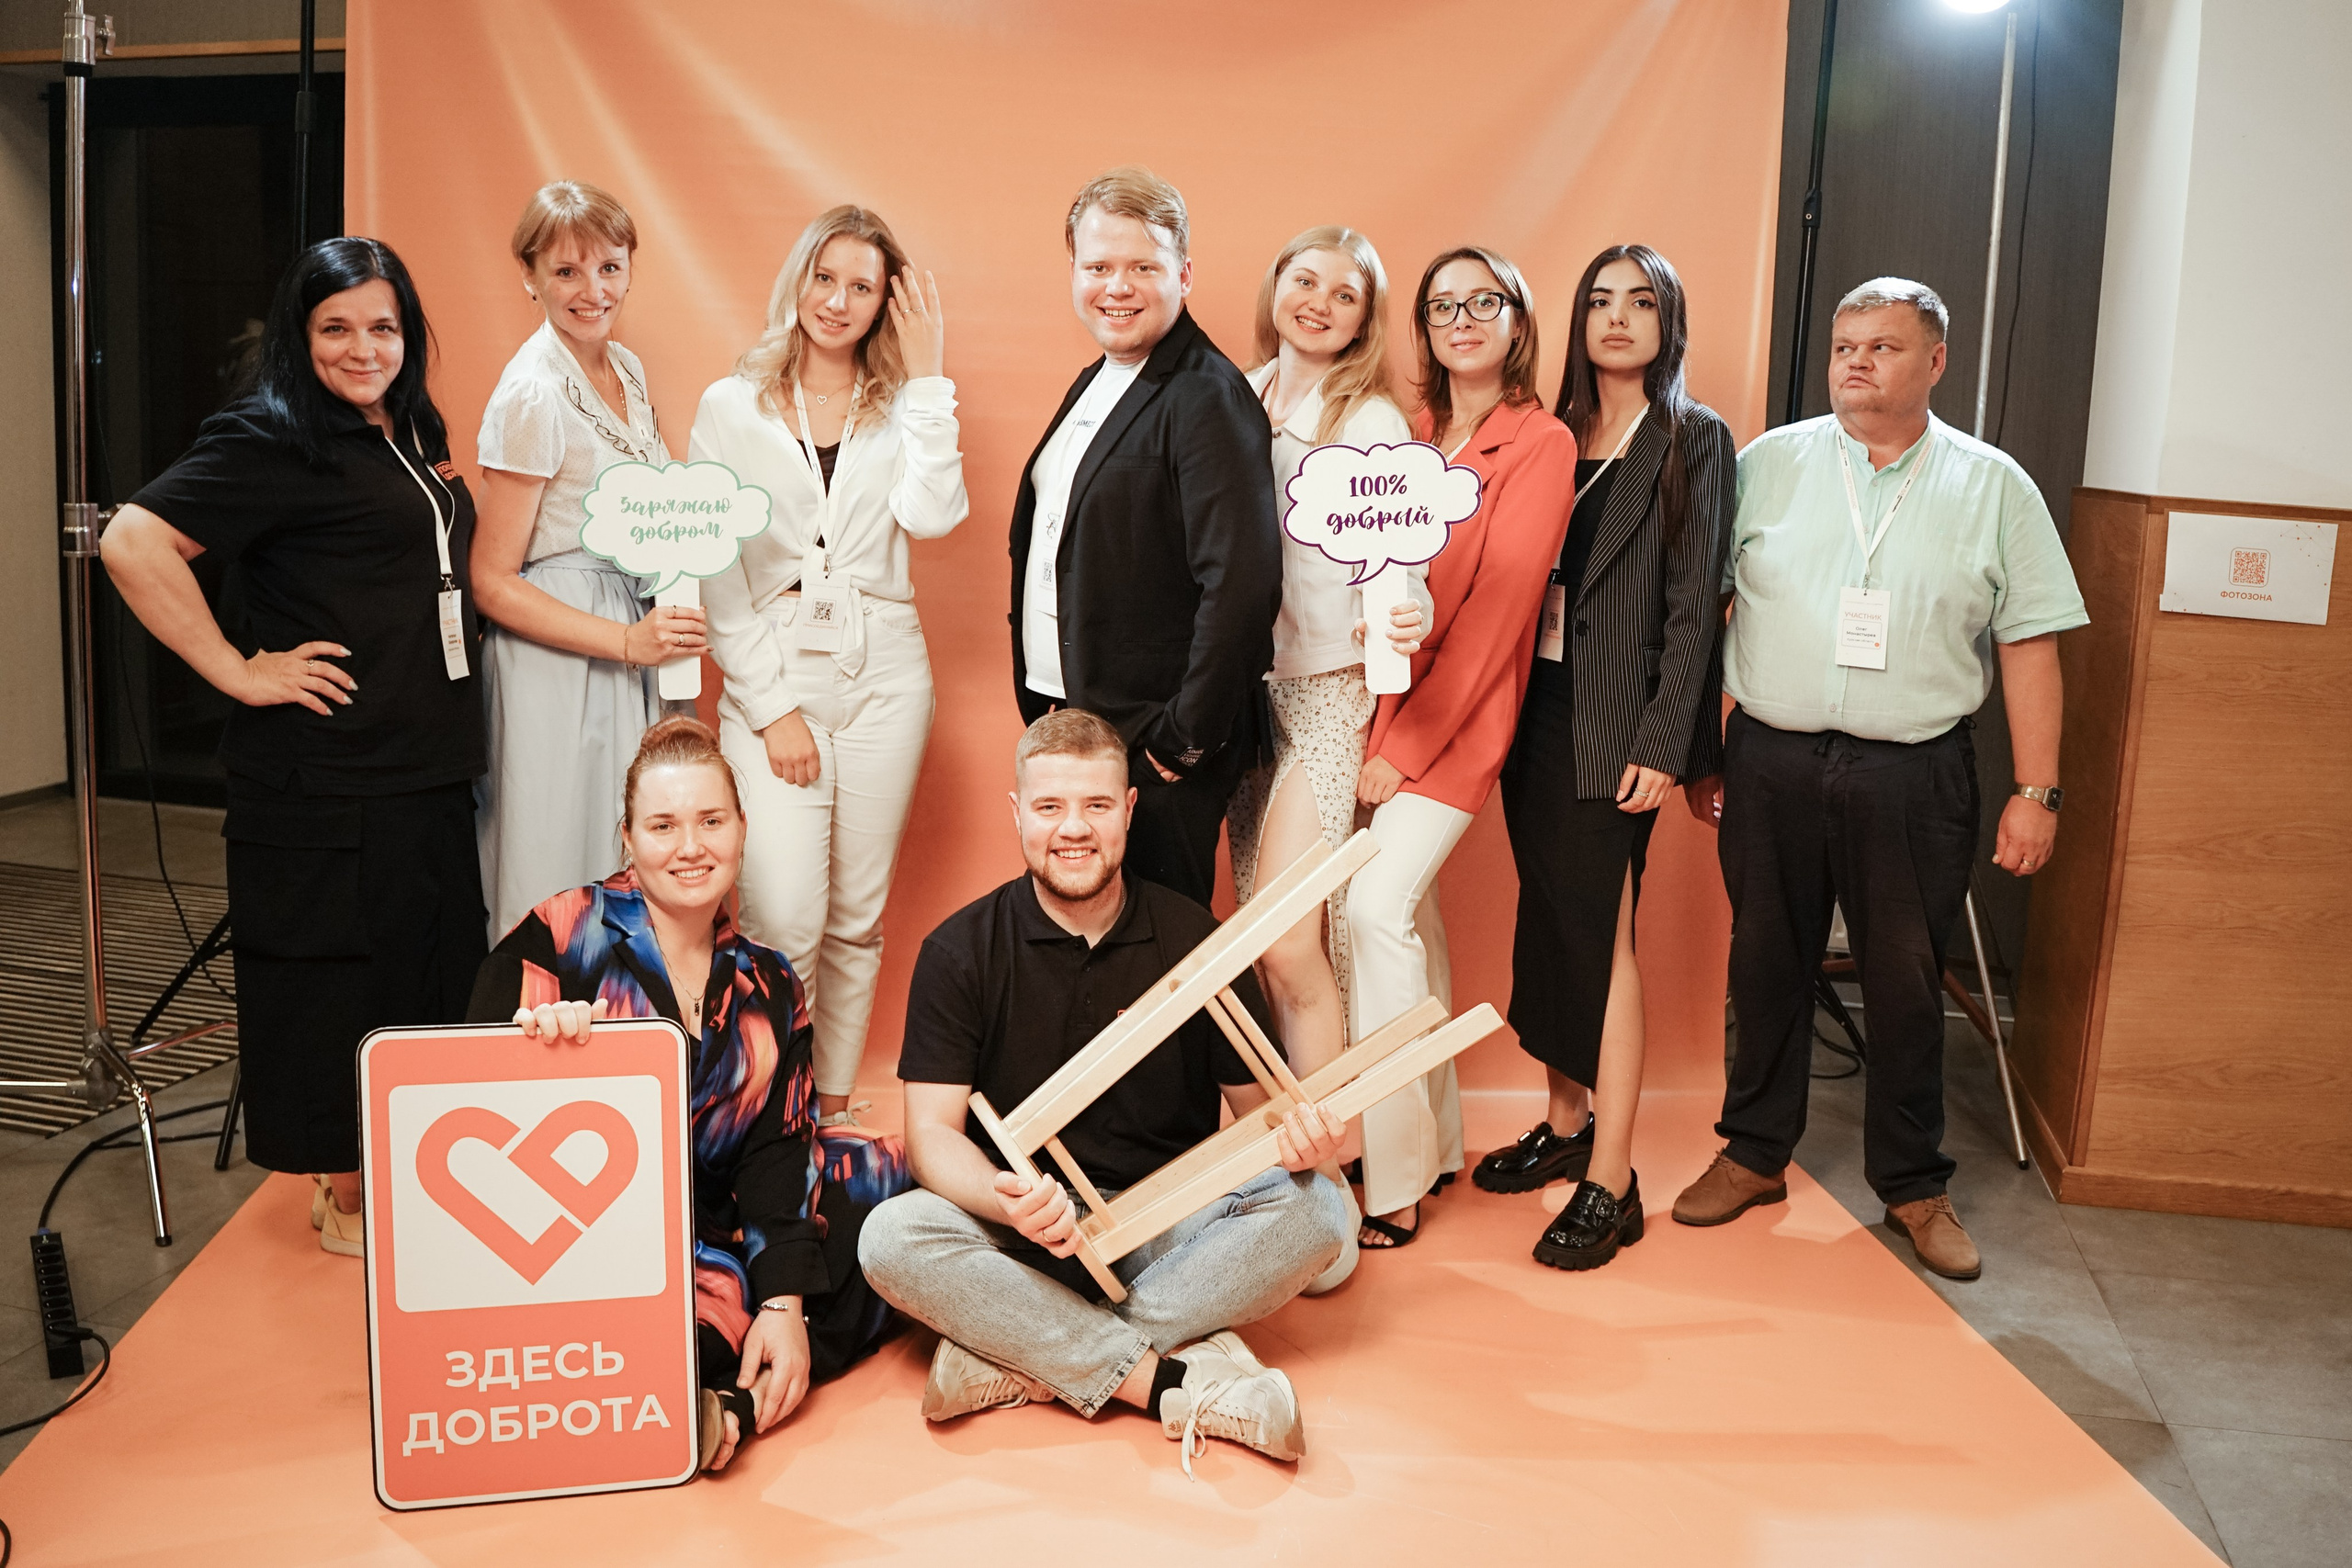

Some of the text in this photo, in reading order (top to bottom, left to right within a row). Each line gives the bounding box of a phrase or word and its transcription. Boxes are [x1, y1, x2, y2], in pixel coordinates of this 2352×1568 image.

[1349, 474, 1408, 497] 100%
[629, 520, 724, 545] добром
[1326, 505, 1435, 536] добрый
[2220, 591, 2273, 602] ФОТОЗОНА
[1844, 611, 1883, 621] УЧАСТНИК
[445, 1341, 625, 1393] ЗДЕСЬ
[401, 1393, 672, 1457] ДОБРОТА
